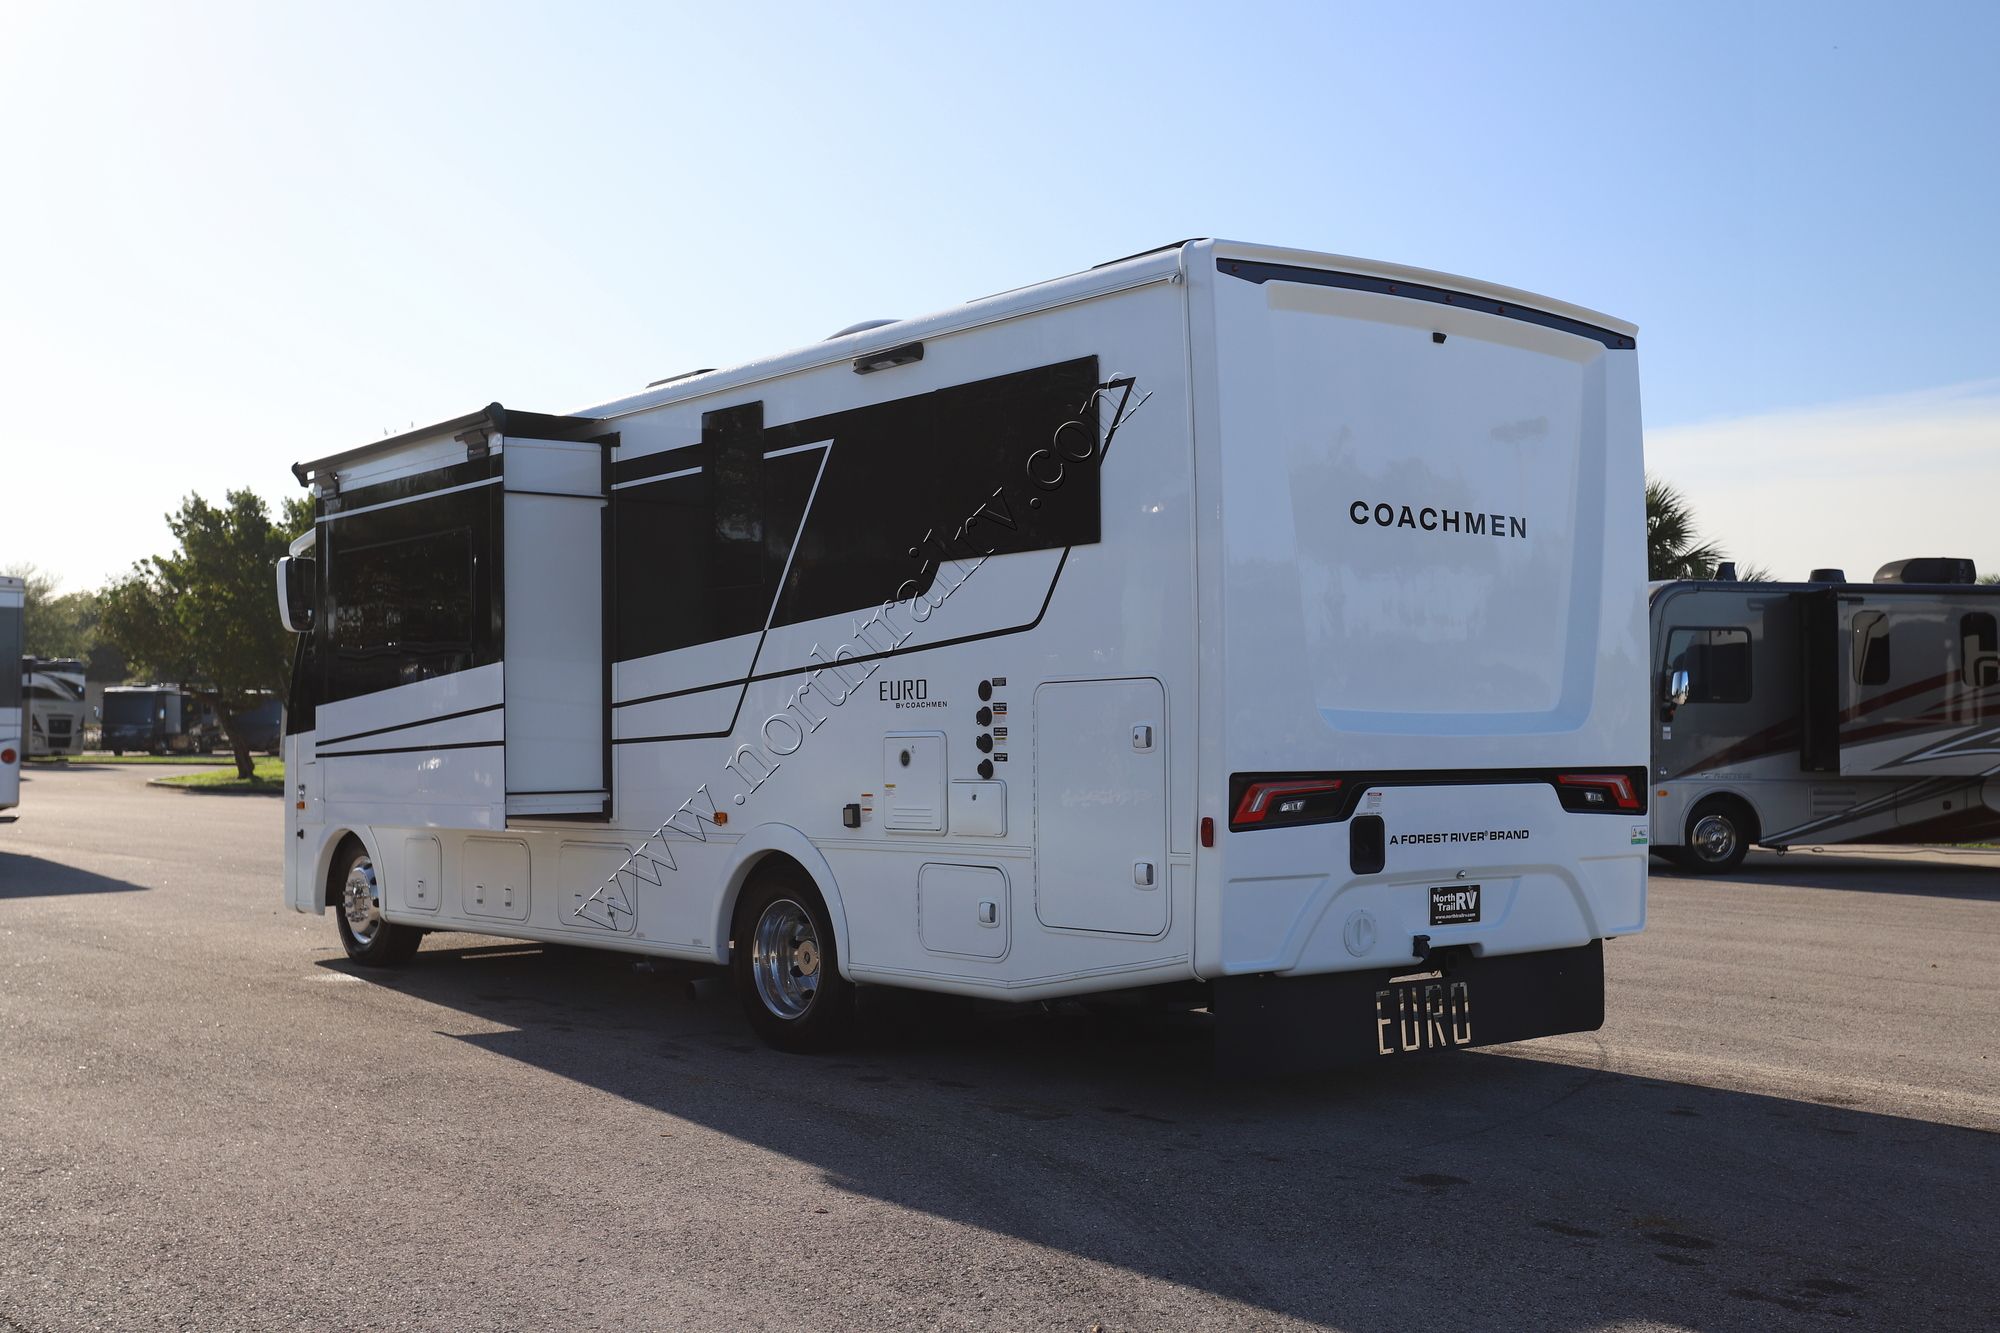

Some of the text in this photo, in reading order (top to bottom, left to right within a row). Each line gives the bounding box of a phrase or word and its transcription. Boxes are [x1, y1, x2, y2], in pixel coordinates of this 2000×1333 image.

[1350, 501, 1527, 539] COACHMEN
[880, 679, 927, 701] EURO
[906, 701, 948, 709] COACHMEN
[1390, 835, 1399, 845] A
[1401, 833, 1448, 845] FOREST
[1489, 830, 1530, 841] BRAND
[1433, 893, 1456, 903] North
[1456, 891, 1478, 911] RV
[1437, 902, 1456, 912] Trail
[1376, 981, 1472, 1055] EURO
